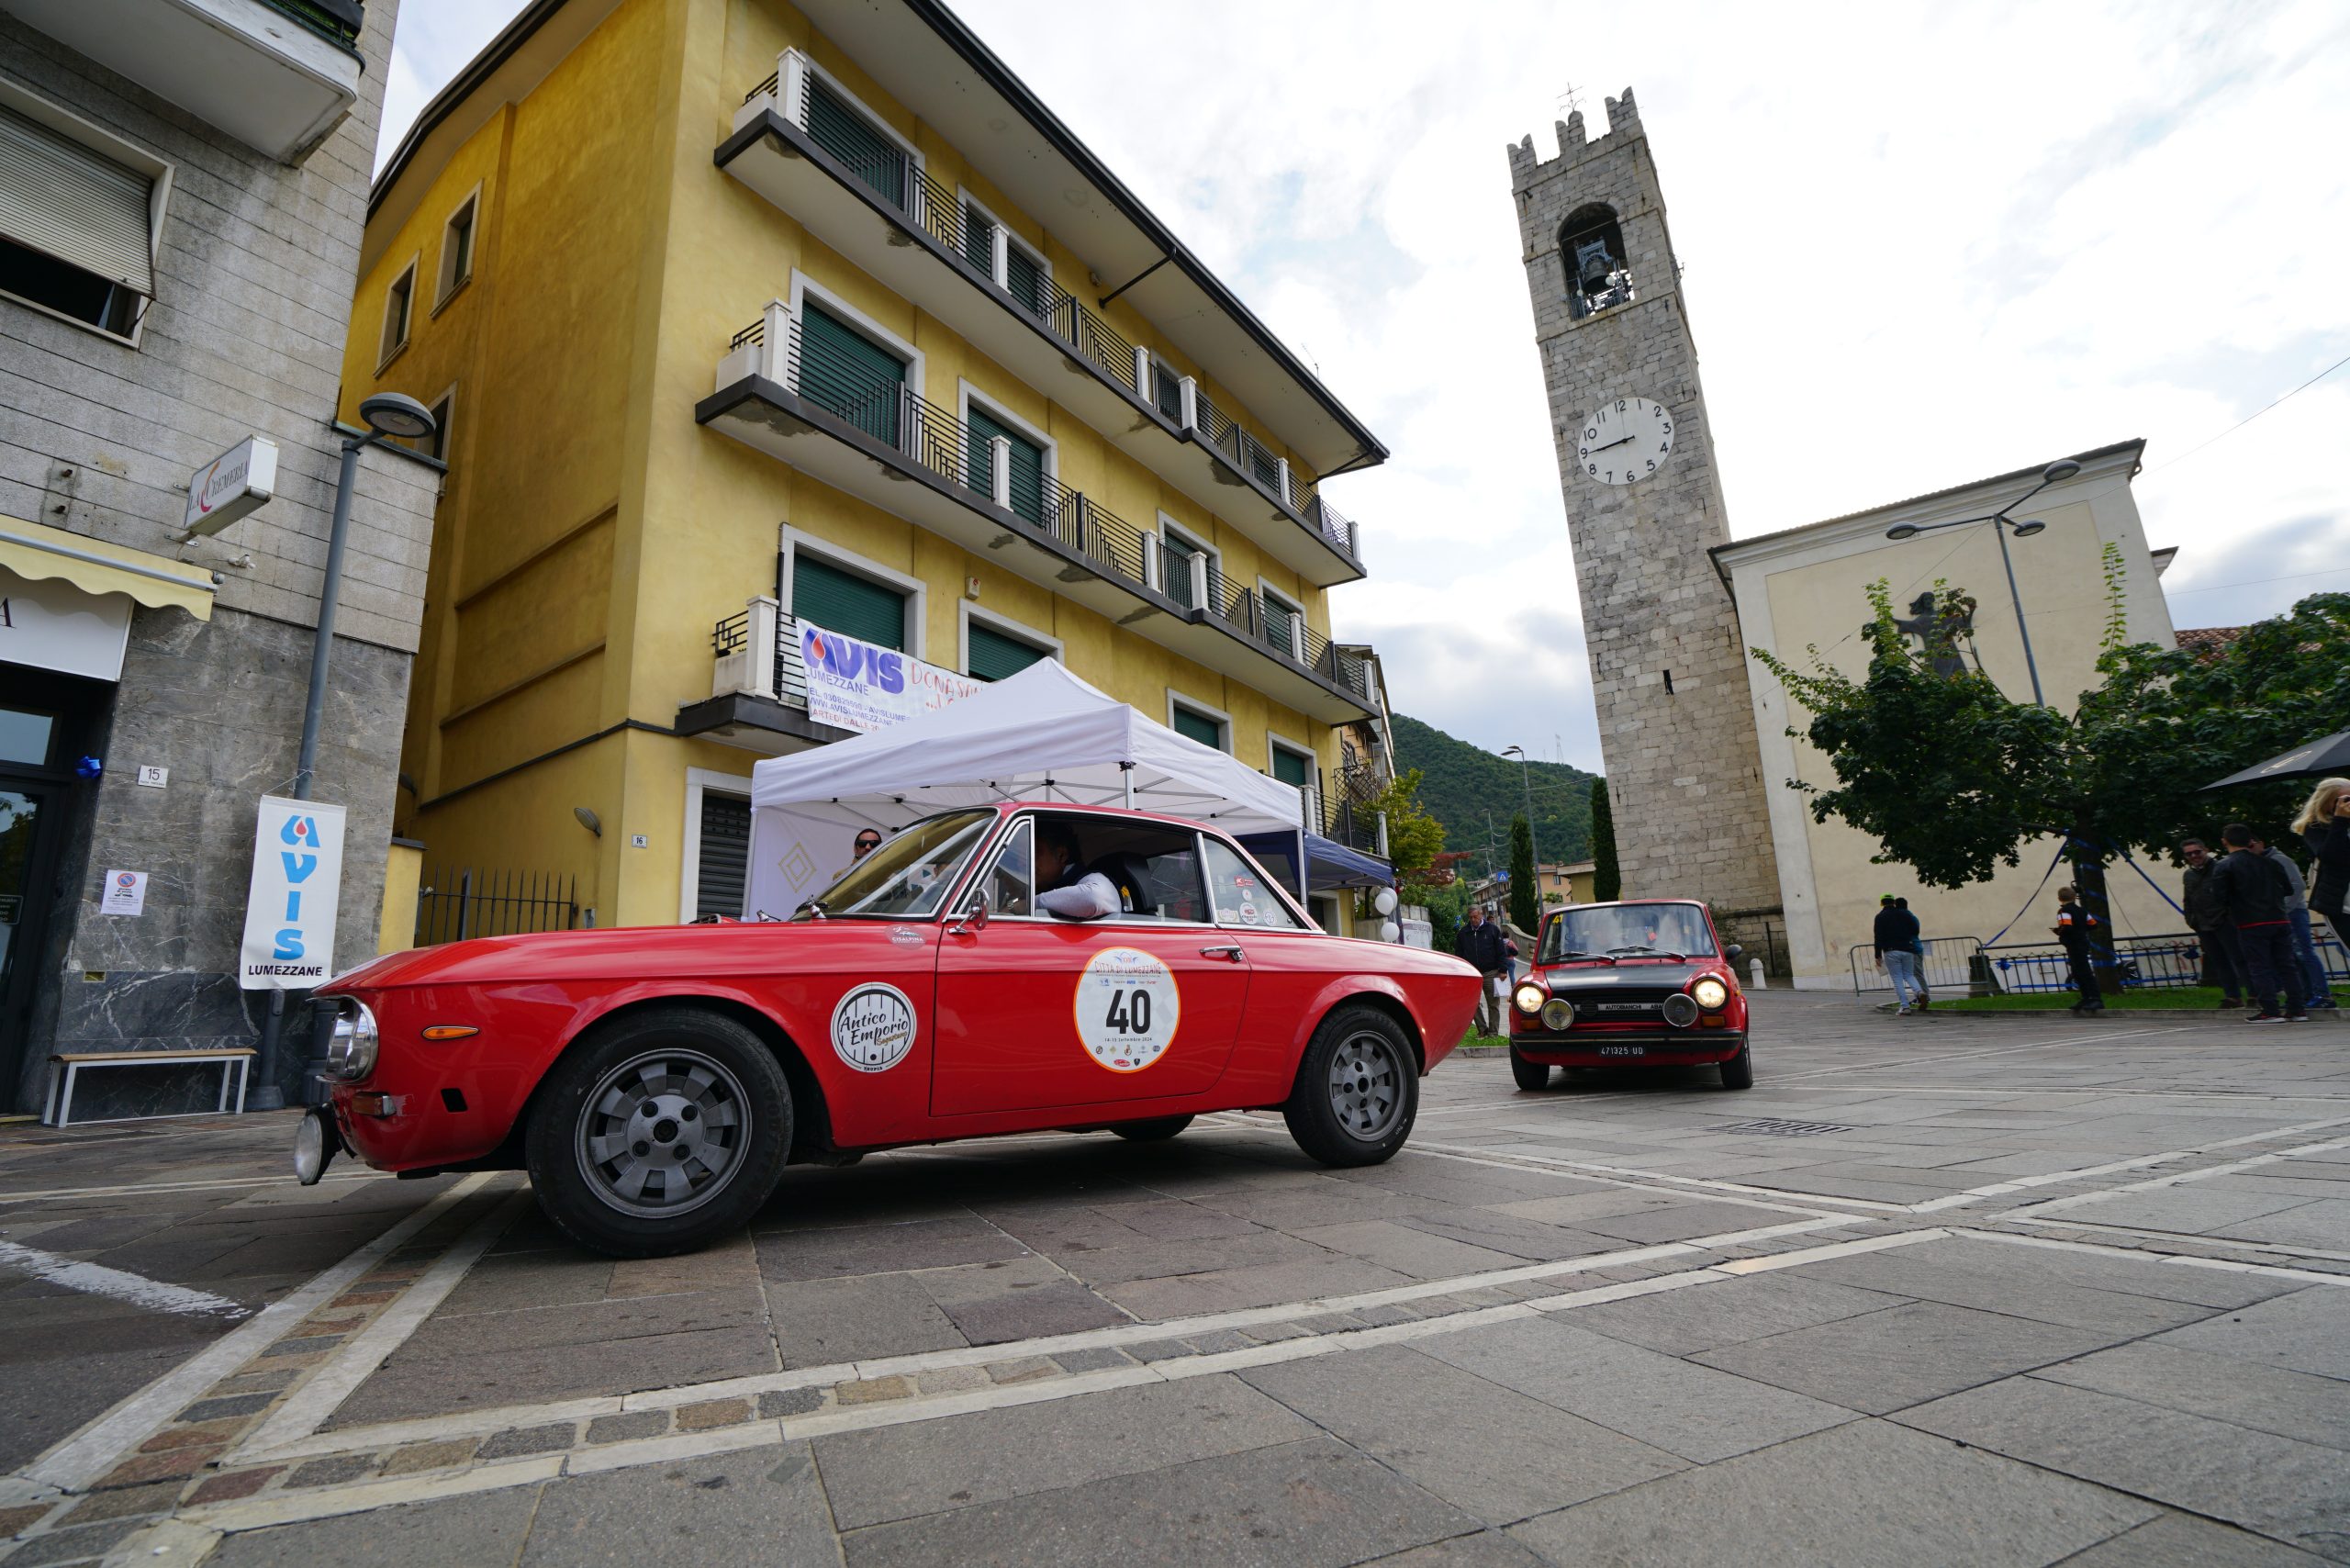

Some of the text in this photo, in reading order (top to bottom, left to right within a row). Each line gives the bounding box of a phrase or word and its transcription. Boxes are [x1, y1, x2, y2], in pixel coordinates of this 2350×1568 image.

[1614, 399, 1626, 413] 12
[1638, 398, 1642, 410] 1
[1596, 410, 1606, 424] 11
[1653, 405, 1662, 417] 2
[1662, 422, 1672, 434] 3
[1583, 428, 1597, 441] 10
[1580, 447, 1588, 459] 9
[1659, 442, 1669, 454] 4
[1588, 464, 1596, 475] 8
[1646, 459, 1656, 471] 5
[1606, 471, 1613, 483] 7
[1626, 470, 1635, 482] 6
[801, 627, 904, 694] AVIS
[812, 709, 842, 722] ARTEDI
[148, 767, 161, 780] 15
[273, 814, 321, 960] AVIS
[248, 965, 323, 977] LUMEZZANE
[1106, 989, 1151, 1035] 40
[840, 1013, 887, 1033] Antico
[851, 1018, 909, 1046] Emporio
[1601, 1047, 1629, 1055] 471325
